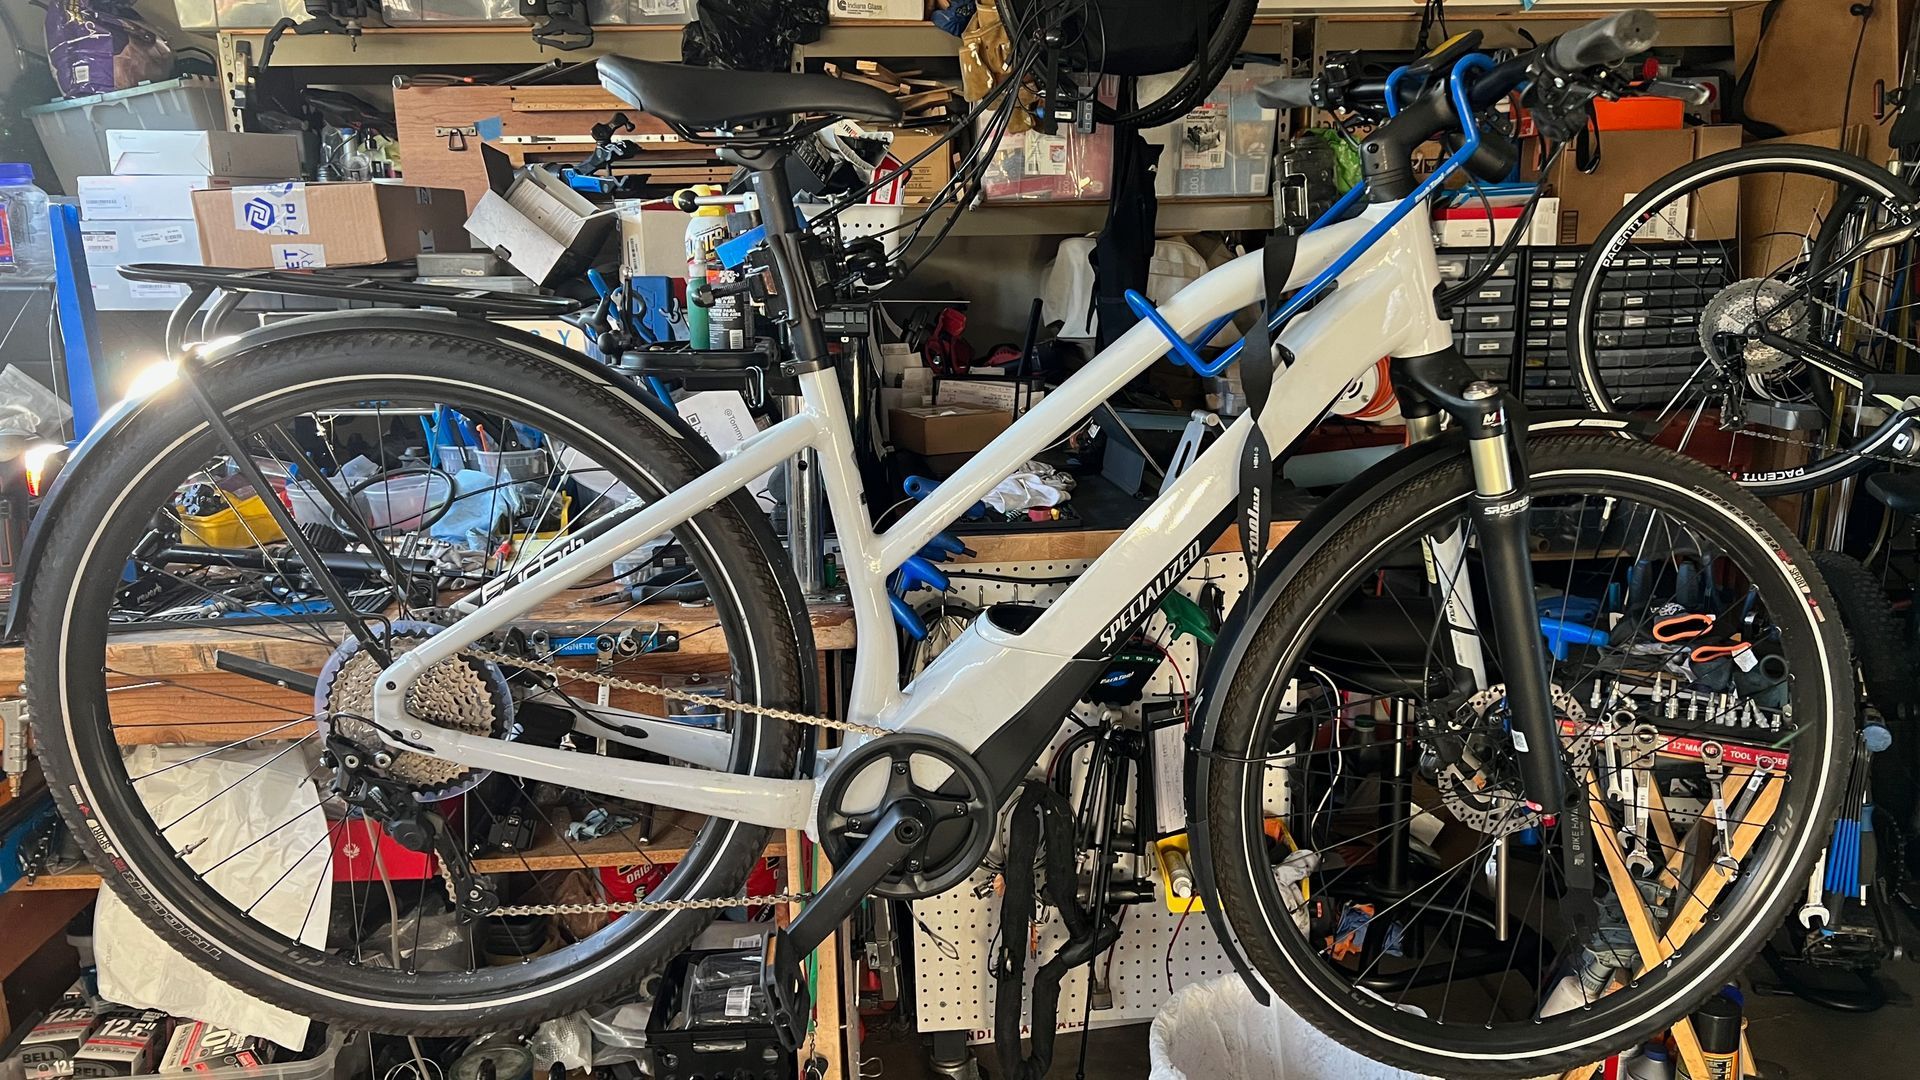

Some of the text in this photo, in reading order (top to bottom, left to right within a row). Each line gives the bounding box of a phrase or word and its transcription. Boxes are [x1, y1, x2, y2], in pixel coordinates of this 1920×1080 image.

[1602, 219, 1643, 268] PACENTI
[723, 408, 745, 442] @Tommy
[1742, 467, 1805, 482] PACENTI
[1789, 567, 1807, 591] SPORT
[1100, 540, 1200, 652] SPECIALIZED
[1730, 750, 1752, 761] TOOL
[90, 824, 112, 851] SPORT
[121, 870, 223, 961] TRIGGER
[100, 1018, 158, 1038] 12.5"
[22, 1050, 59, 1064] BELL
